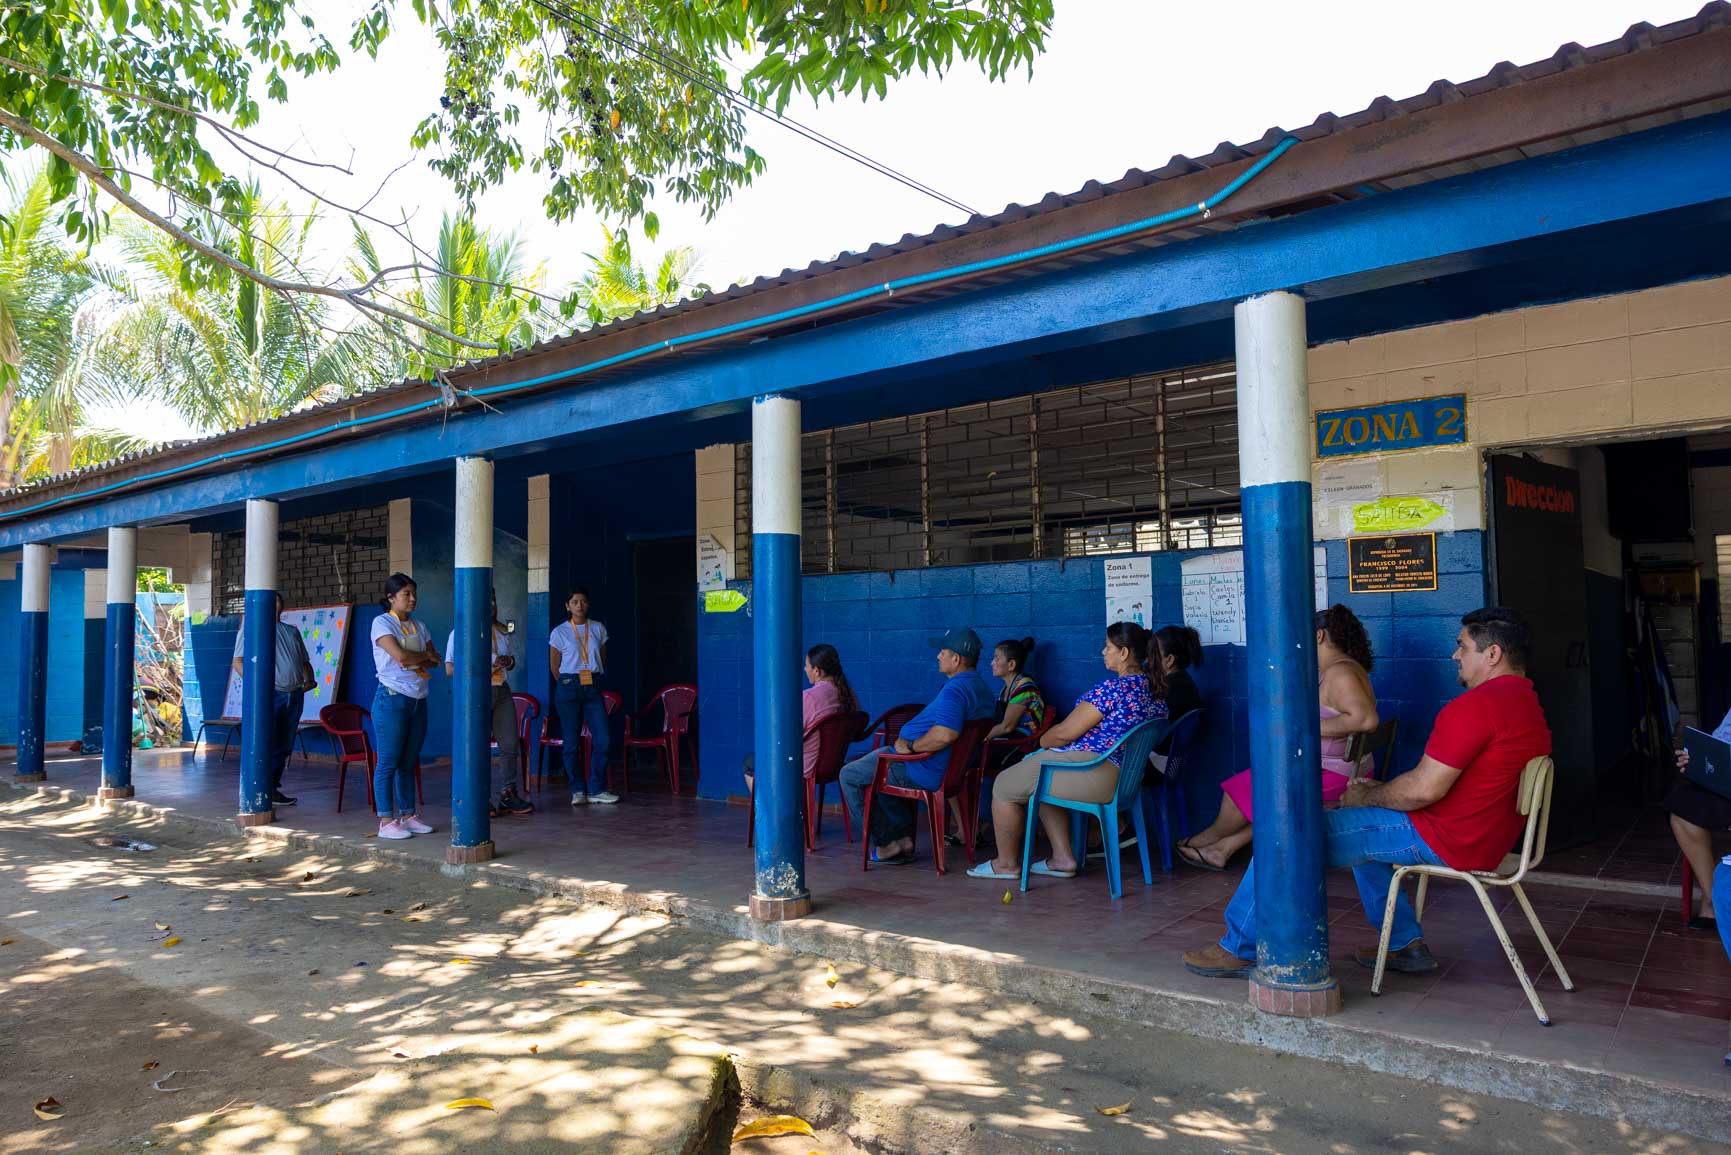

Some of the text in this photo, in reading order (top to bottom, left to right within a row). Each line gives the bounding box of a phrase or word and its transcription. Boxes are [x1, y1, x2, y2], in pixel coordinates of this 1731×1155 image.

[1320, 407, 1460, 447] ZONA 2
[1358, 505, 1422, 525] SALIDA
